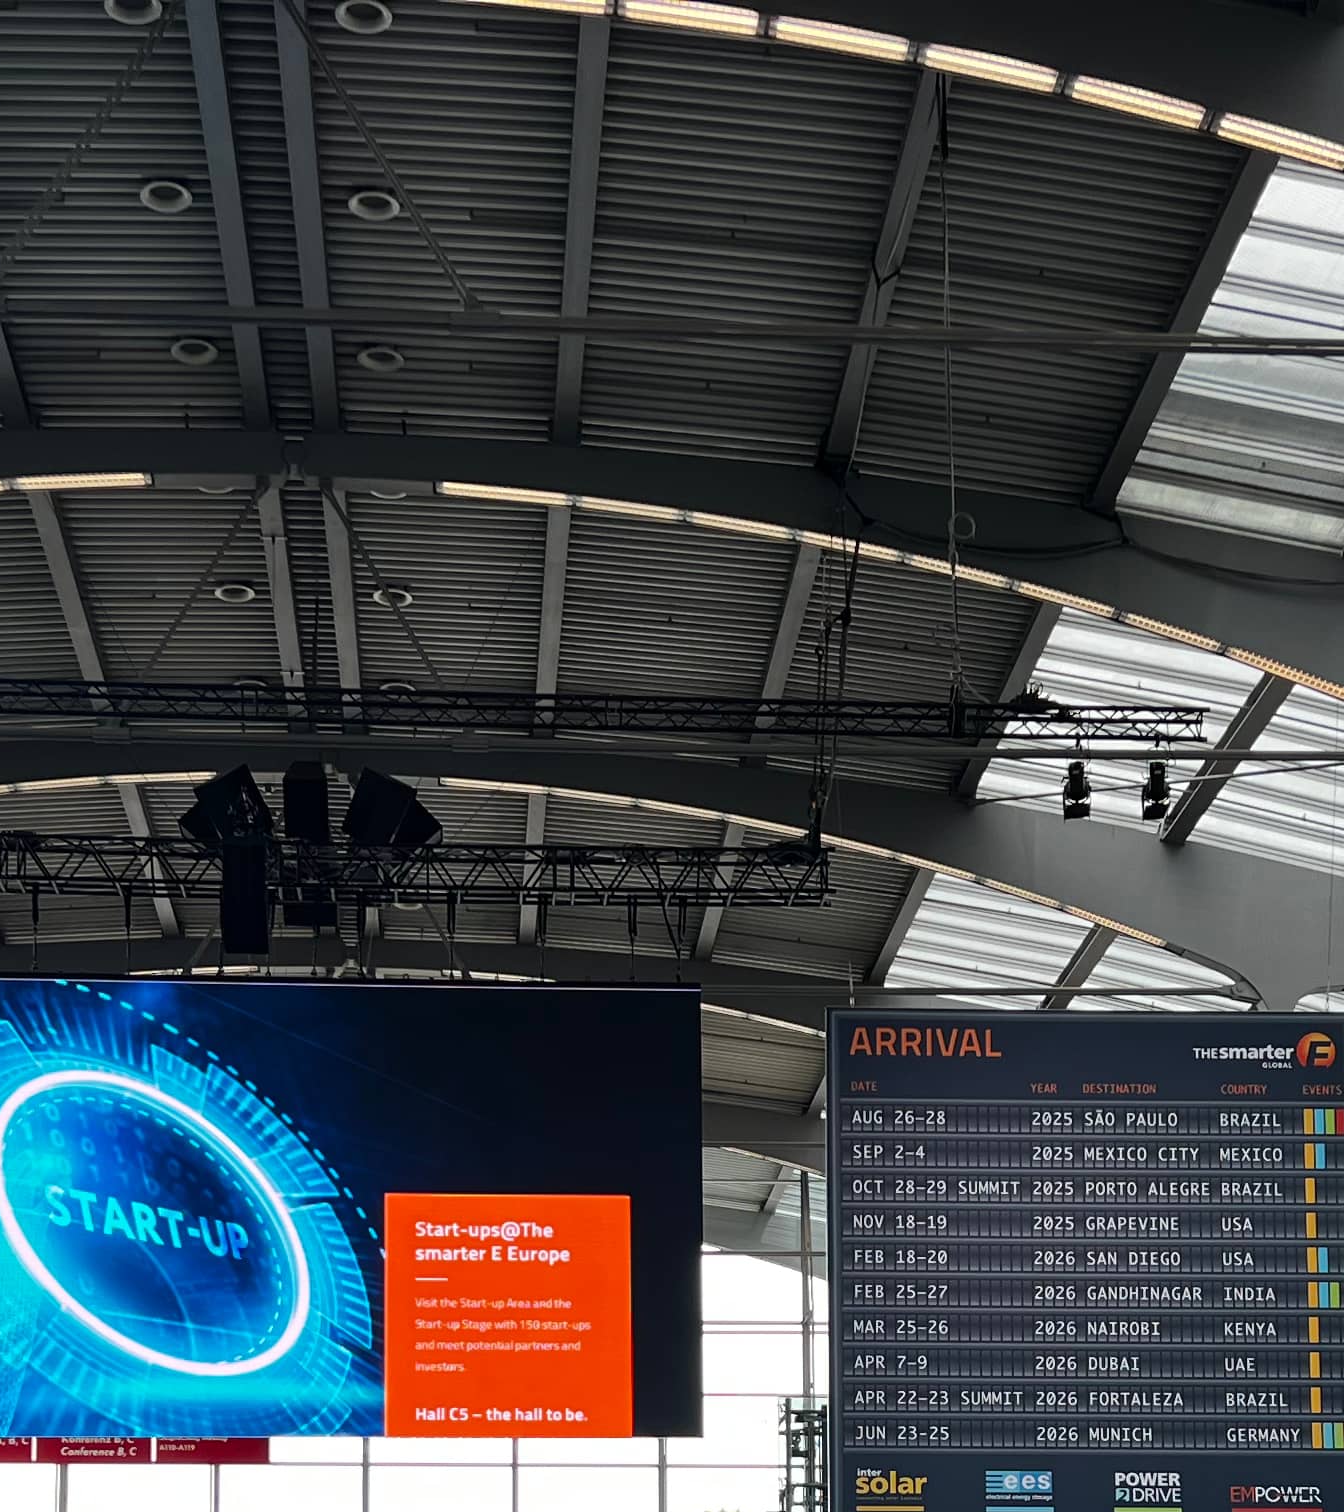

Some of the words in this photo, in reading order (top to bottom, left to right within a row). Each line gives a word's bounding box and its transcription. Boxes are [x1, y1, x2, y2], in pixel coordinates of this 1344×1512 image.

[851, 1028, 1001, 1057] ARRIVAL
[1193, 1045, 1294, 1059] THEsmarter
[851, 1080, 877, 1092] DATE
[1031, 1082, 1057, 1094] YEAR
[1082, 1083, 1157, 1094] DESTINATION
[1220, 1084, 1267, 1096] COUNTRY
[1302, 1085, 1342, 1096] EVENTS
[852, 1109, 884, 1126] AUG
[1032, 1111, 1073, 1127] 2025
[1084, 1110, 1116, 1127] SÃO
[1126, 1111, 1178, 1128] PAULO
[1219, 1112, 1281, 1128] BRAZIL
[853, 1145, 883, 1160] SEP
[1032, 1146, 1074, 1162] 2025
[1084, 1146, 1147, 1163] MEXICO
[1158, 1147, 1200, 1163] CITY
[1219, 1147, 1283, 1163] MEXICO
[852, 1179, 884, 1195] OCT
[958, 1181, 1020, 1196] SUMMIT
[1033, 1181, 1075, 1197] 2025
[1085, 1181, 1137, 1197] PORTO
[1148, 1182, 1210, 1198] ALEGRE
[1221, 1182, 1283, 1198] BRAZIL
[45, 1185, 249, 1259] START-UP
[853, 1214, 885, 1230] NOV
[1033, 1216, 1075, 1232] 2025
[1085, 1216, 1179, 1232] GRAPEVINE
[1222, 1217, 1253, 1232] USA
[416, 1222, 553, 1241] Start-ups@The
[416, 1247, 486, 1260] smarter
[492, 1246, 501, 1261] E
[508, 1246, 570, 1265] Europe
[854, 1250, 885, 1265] FEB
[1034, 1251, 1076, 1267] 2026
[1086, 1251, 1119, 1267] SAN
[1129, 1251, 1181, 1267] DIEGO
[1223, 1252, 1254, 1268] USA
[854, 1285, 885, 1300] FEB
[1034, 1286, 1076, 1302] 2026
[1087, 1286, 1202, 1302] GANDHINAGAR
[1223, 1286, 1275, 1302] INDIA
[415, 1298, 437, 1308] Visit
[462, 1320, 492, 1330] Stage
[853, 1320, 885, 1335] MAR
[1035, 1321, 1077, 1337] 2026
[1087, 1321, 1161, 1337] NAIROBI
[1224, 1321, 1276, 1337] KENYA
[437, 1340, 464, 1350] meet
[854, 1355, 885, 1370] APR
[1035, 1356, 1077, 1372] 2026
[1088, 1356, 1140, 1372] DUBAI
[1225, 1357, 1256, 1373] UAE
[854, 1390, 886, 1405] APR
[961, 1390, 1023, 1407] SUMMIT
[1036, 1391, 1078, 1407] 2026
[1089, 1391, 1184, 1407] FORTALEZA
[1226, 1391, 1288, 1407] BRAZIL
[415, 1408, 444, 1421] Hall
[450, 1408, 468, 1421] C5
[487, 1409, 511, 1421] the
[516, 1408, 542, 1421] hall
[546, 1410, 561, 1421] to
[565, 1409, 587, 1421] be.
[856, 1426, 886, 1441] JUN
[1036, 1426, 1079, 1442] 2026
[1089, 1426, 1153, 1442] MUNICH
[1227, 1427, 1300, 1443] GERMANY
[60, 1447, 115, 1456] Conference
[117, 1447, 127, 1458] B,
[128, 1447, 137, 1456] C
[857, 1468, 882, 1477] inter
[856, 1471, 927, 1494] solar
[1003, 1475, 1050, 1490] ees
[1115, 1473, 1181, 1486] POWER
[1231, 1487, 1322, 1503] EMPOWER
